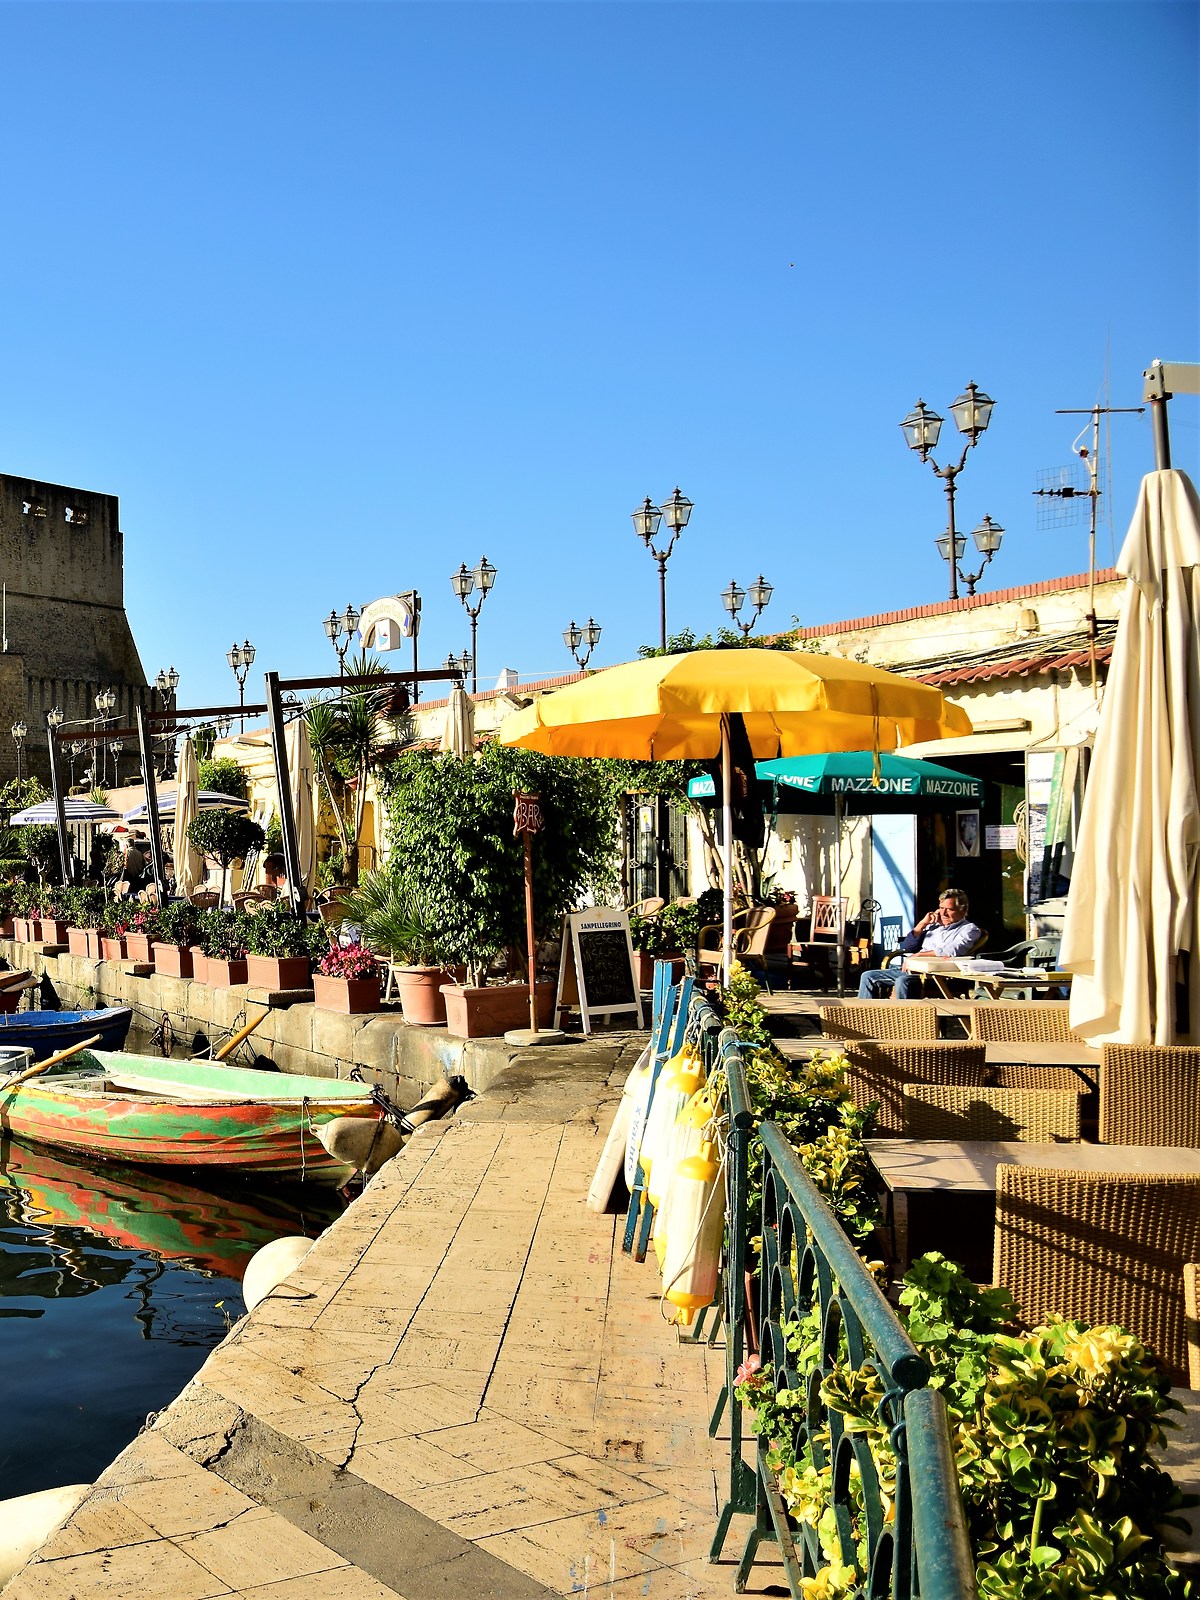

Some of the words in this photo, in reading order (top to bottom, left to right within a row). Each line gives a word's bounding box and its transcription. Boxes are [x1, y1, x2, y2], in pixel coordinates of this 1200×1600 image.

[831, 777, 913, 792] MAZZONE
[926, 779, 980, 797] MAZZONE
[518, 802, 541, 830] BAR
[580, 921, 622, 930] SANPELLEGRINO
